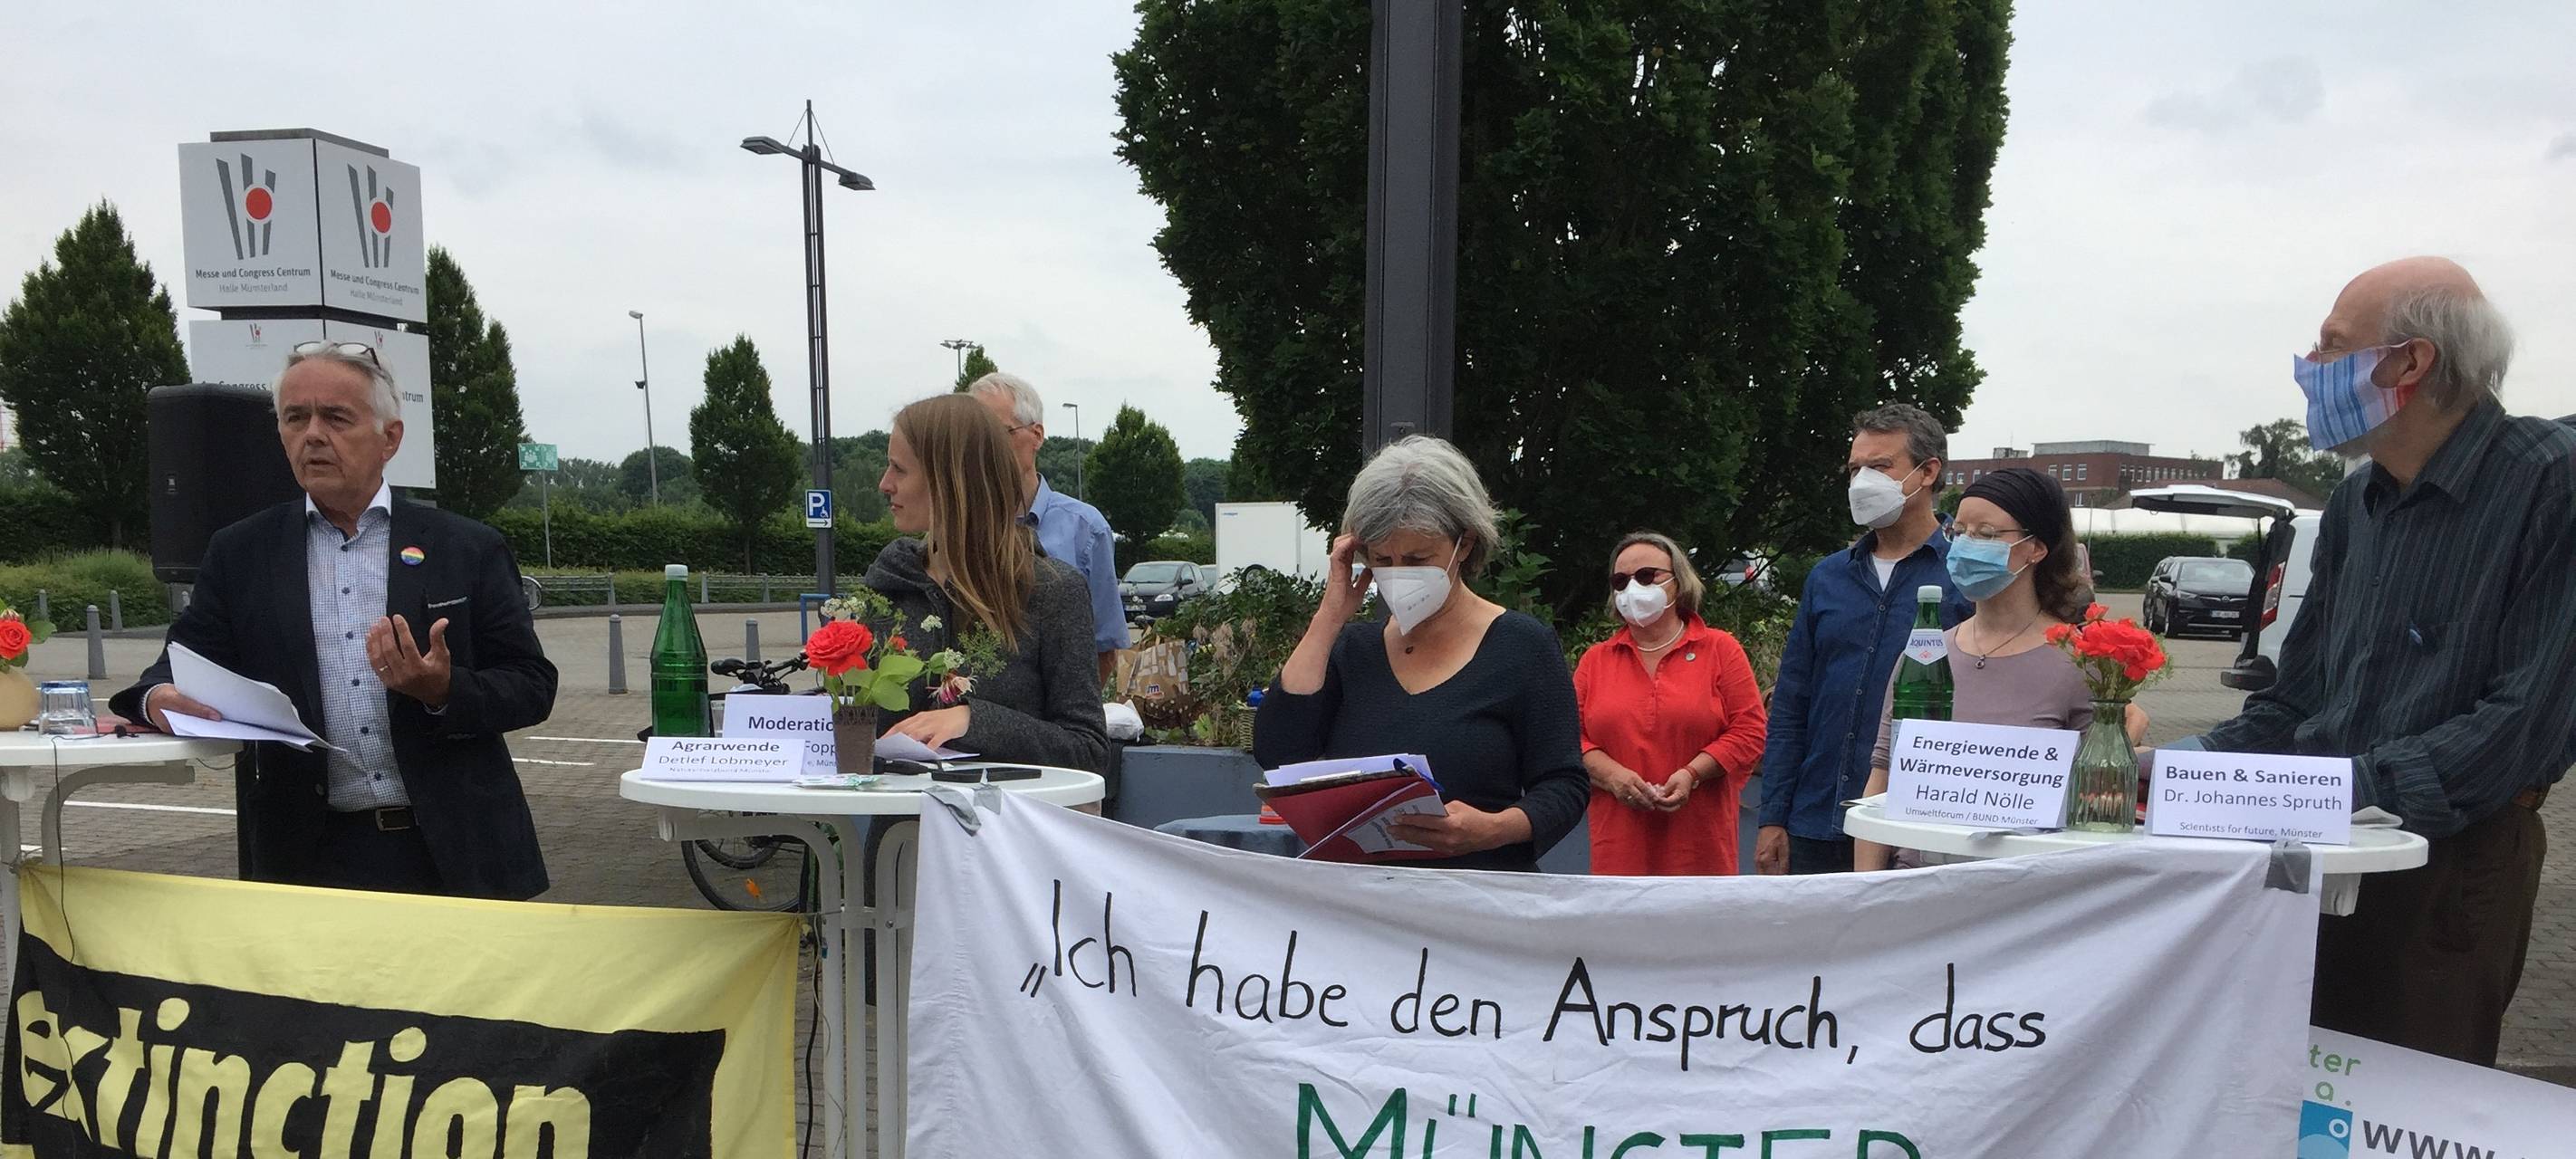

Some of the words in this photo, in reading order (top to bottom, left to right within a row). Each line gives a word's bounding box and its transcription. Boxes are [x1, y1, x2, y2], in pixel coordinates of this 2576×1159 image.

[196, 269, 219, 279] Messe
[222, 268, 237, 278] und
[239, 268, 275, 280] Congress
[277, 267, 311, 277] Centrum
[331, 269, 351, 282] Messe
[352, 275, 364, 284] und
[366, 276, 393, 291] Congress
[395, 282, 419, 295] Centrum
[219, 283, 238, 292] Halle
[808, 493, 825, 516] P
[748, 716, 834, 732] Moderatio
[671, 741, 780, 752] Agrarwende
[1912, 736, 2039, 761] Energiewende
[2044, 747, 2059, 761] &
[658, 755, 706, 764] Detlef
[711, 756, 788, 767] Lobmeyer
[1900, 758, 2064, 789] Wärmeversorgung
[2166, 766, 2226, 781] Bauen
[2234, 769, 2248, 782] &
[2254, 770, 2341, 786] Sanieren
[1916, 785, 1978, 805] Harald
[1985, 790, 2034, 810] Nölle
[2165, 790, 2188, 803] Dr.
[2194, 790, 2277, 807] Johannes
[2282, 794, 2342, 811] Spruth
[1905, 806, 1964, 819] Umweltforum
[1973, 813, 1999, 823] BUND
[2001, 815, 2038, 826] Münster
[2180, 821, 2225, 833] Scientists
[2227, 824, 2242, 835] for
[2244, 826, 2278, 837] future,
[2281, 829, 2323, 838] Münster
[1186, 909, 1349, 1027] habe
[1390, 947, 1502, 1039] den
[1543, 956, 1860, 1071] Anspruch,
[1909, 963, 2047, 1053] dass
[15, 989, 591, 1159] extinction
